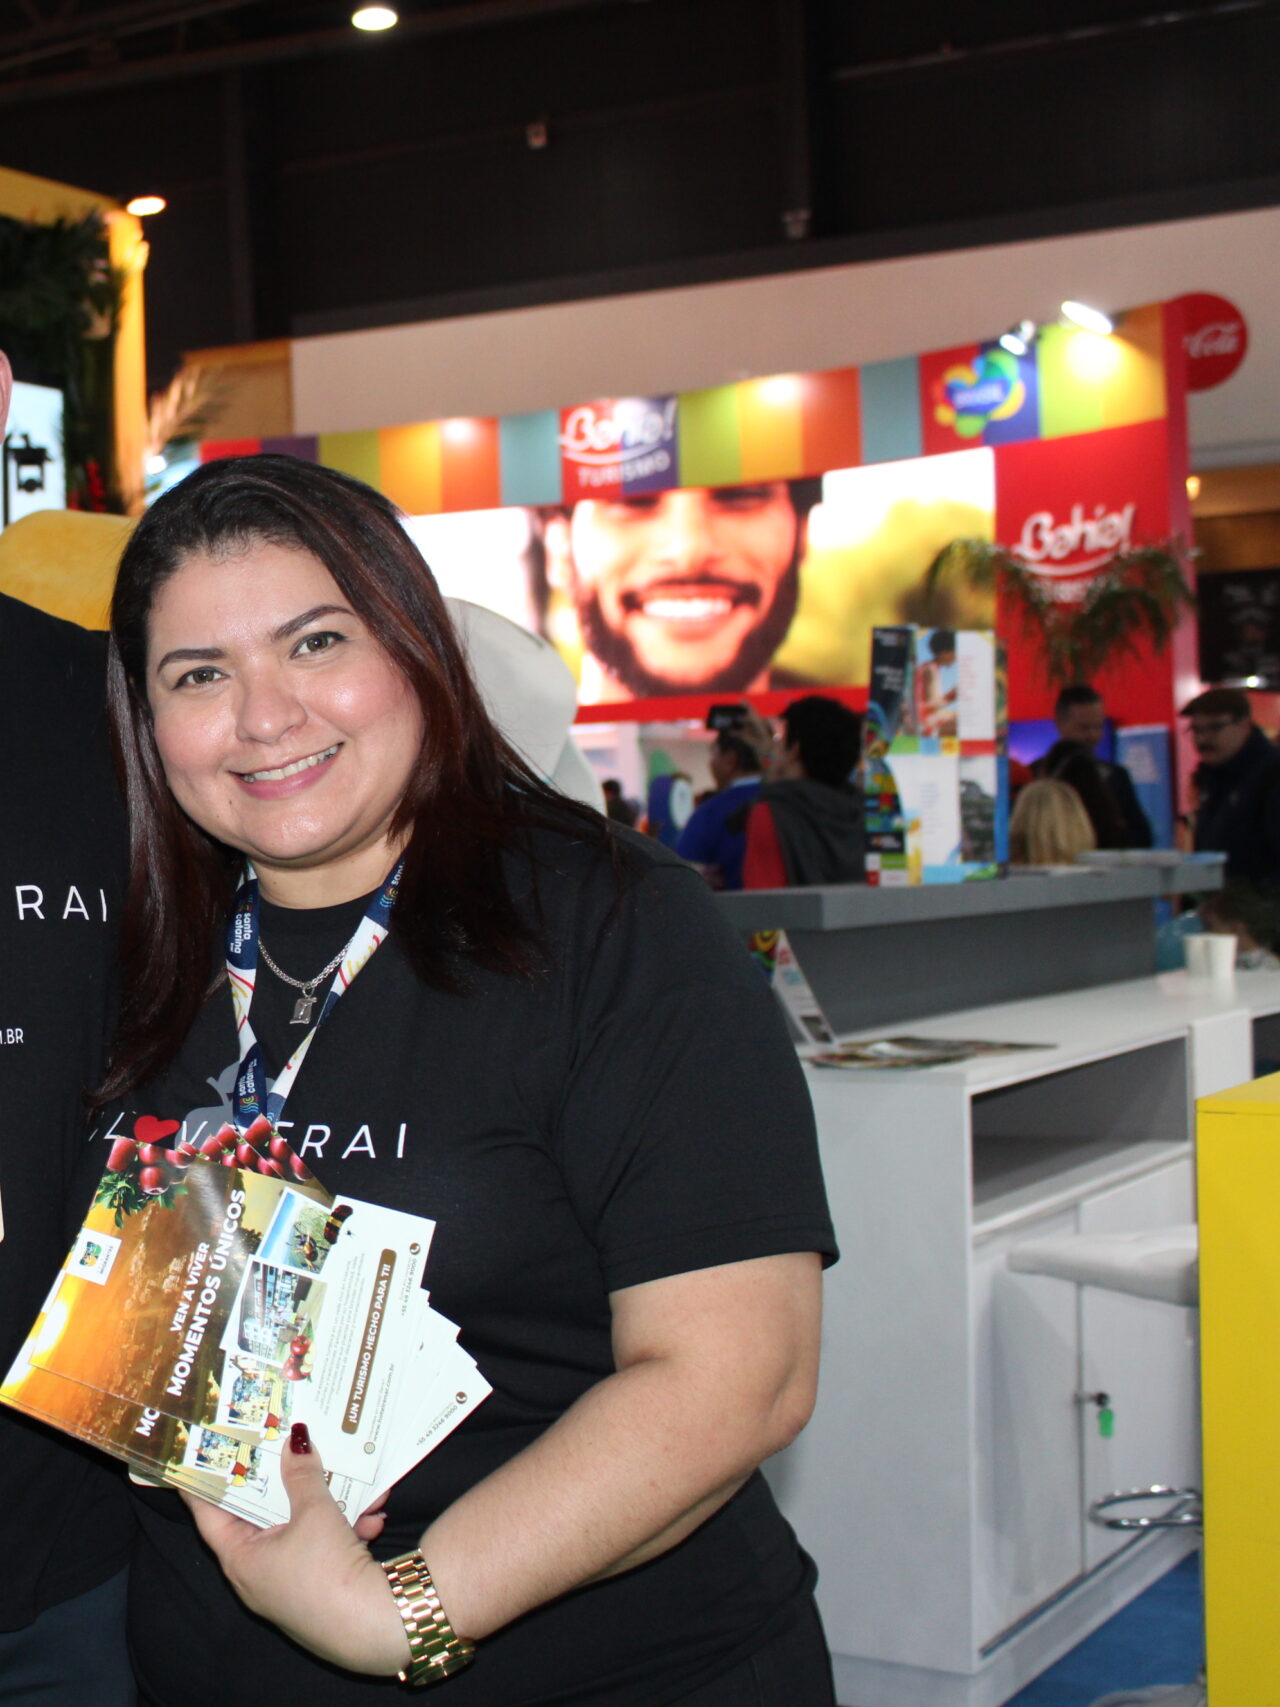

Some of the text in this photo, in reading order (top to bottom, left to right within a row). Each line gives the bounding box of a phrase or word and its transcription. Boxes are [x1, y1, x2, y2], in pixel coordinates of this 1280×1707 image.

[234, 913, 244, 954] catarina
[243, 912, 253, 940] santa
[170, 1242, 210, 1333] VEN A VIVER
[380, 1263, 391, 1278] TI!
[166, 1188, 246, 1396] MOMENTOS ÚNICOS
[374, 1279, 388, 1308] PARA
[364, 1310, 380, 1350] HECHO
[351, 1350, 372, 1401] TURISMO
